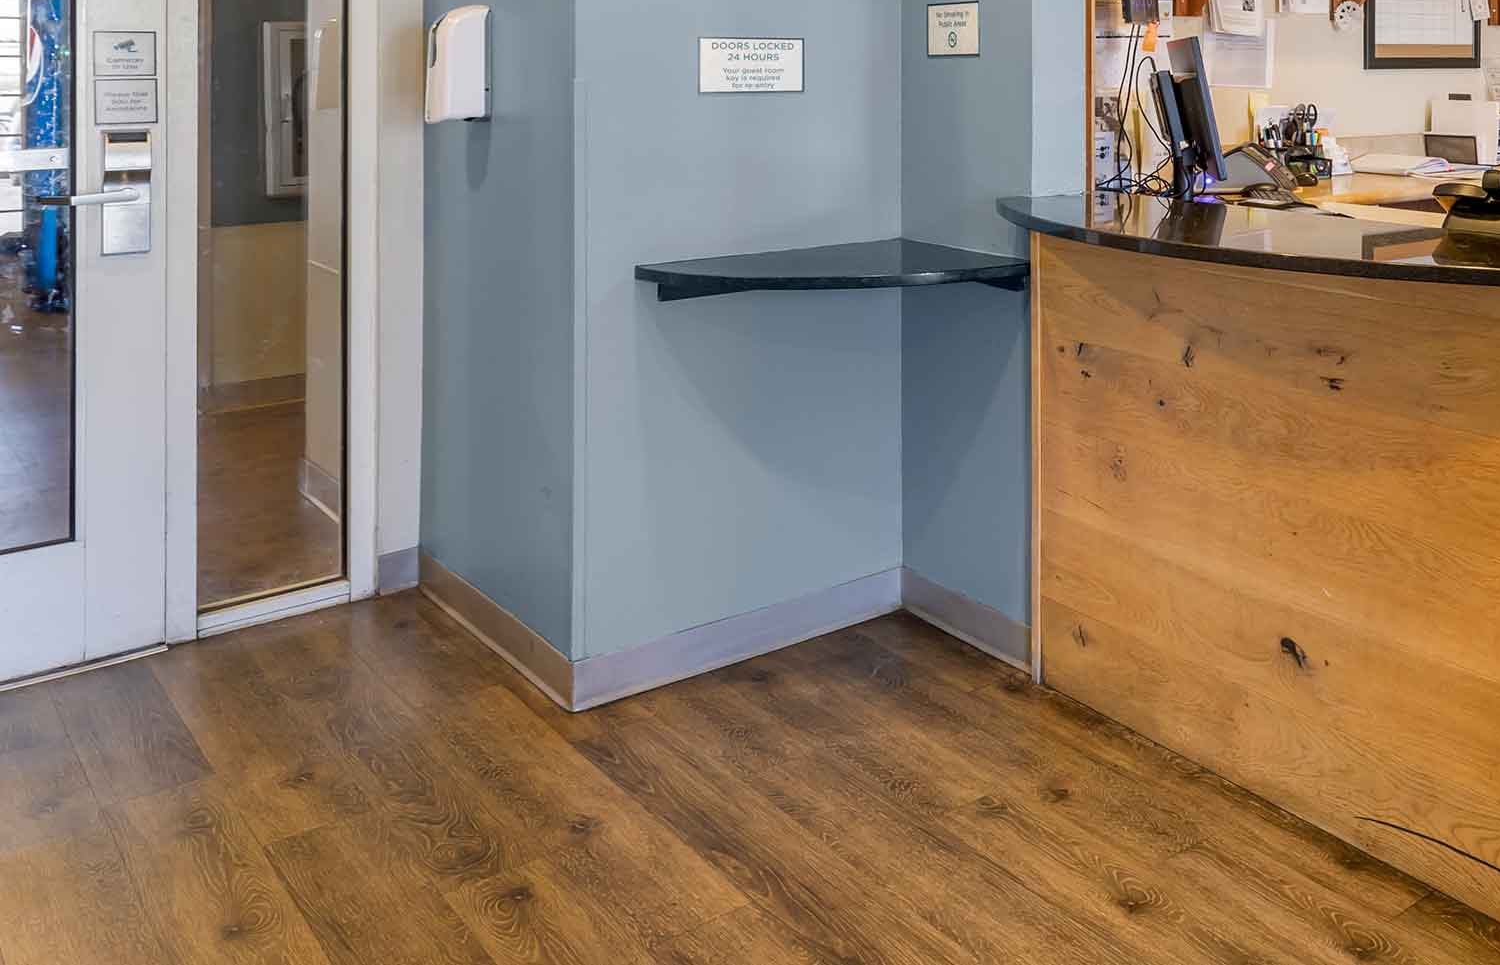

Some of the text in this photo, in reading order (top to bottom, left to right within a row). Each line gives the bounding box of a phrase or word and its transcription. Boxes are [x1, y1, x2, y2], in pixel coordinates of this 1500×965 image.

[711, 42, 794, 50] DOORS LOCKED
[727, 53, 780, 61] 24 HOURS
